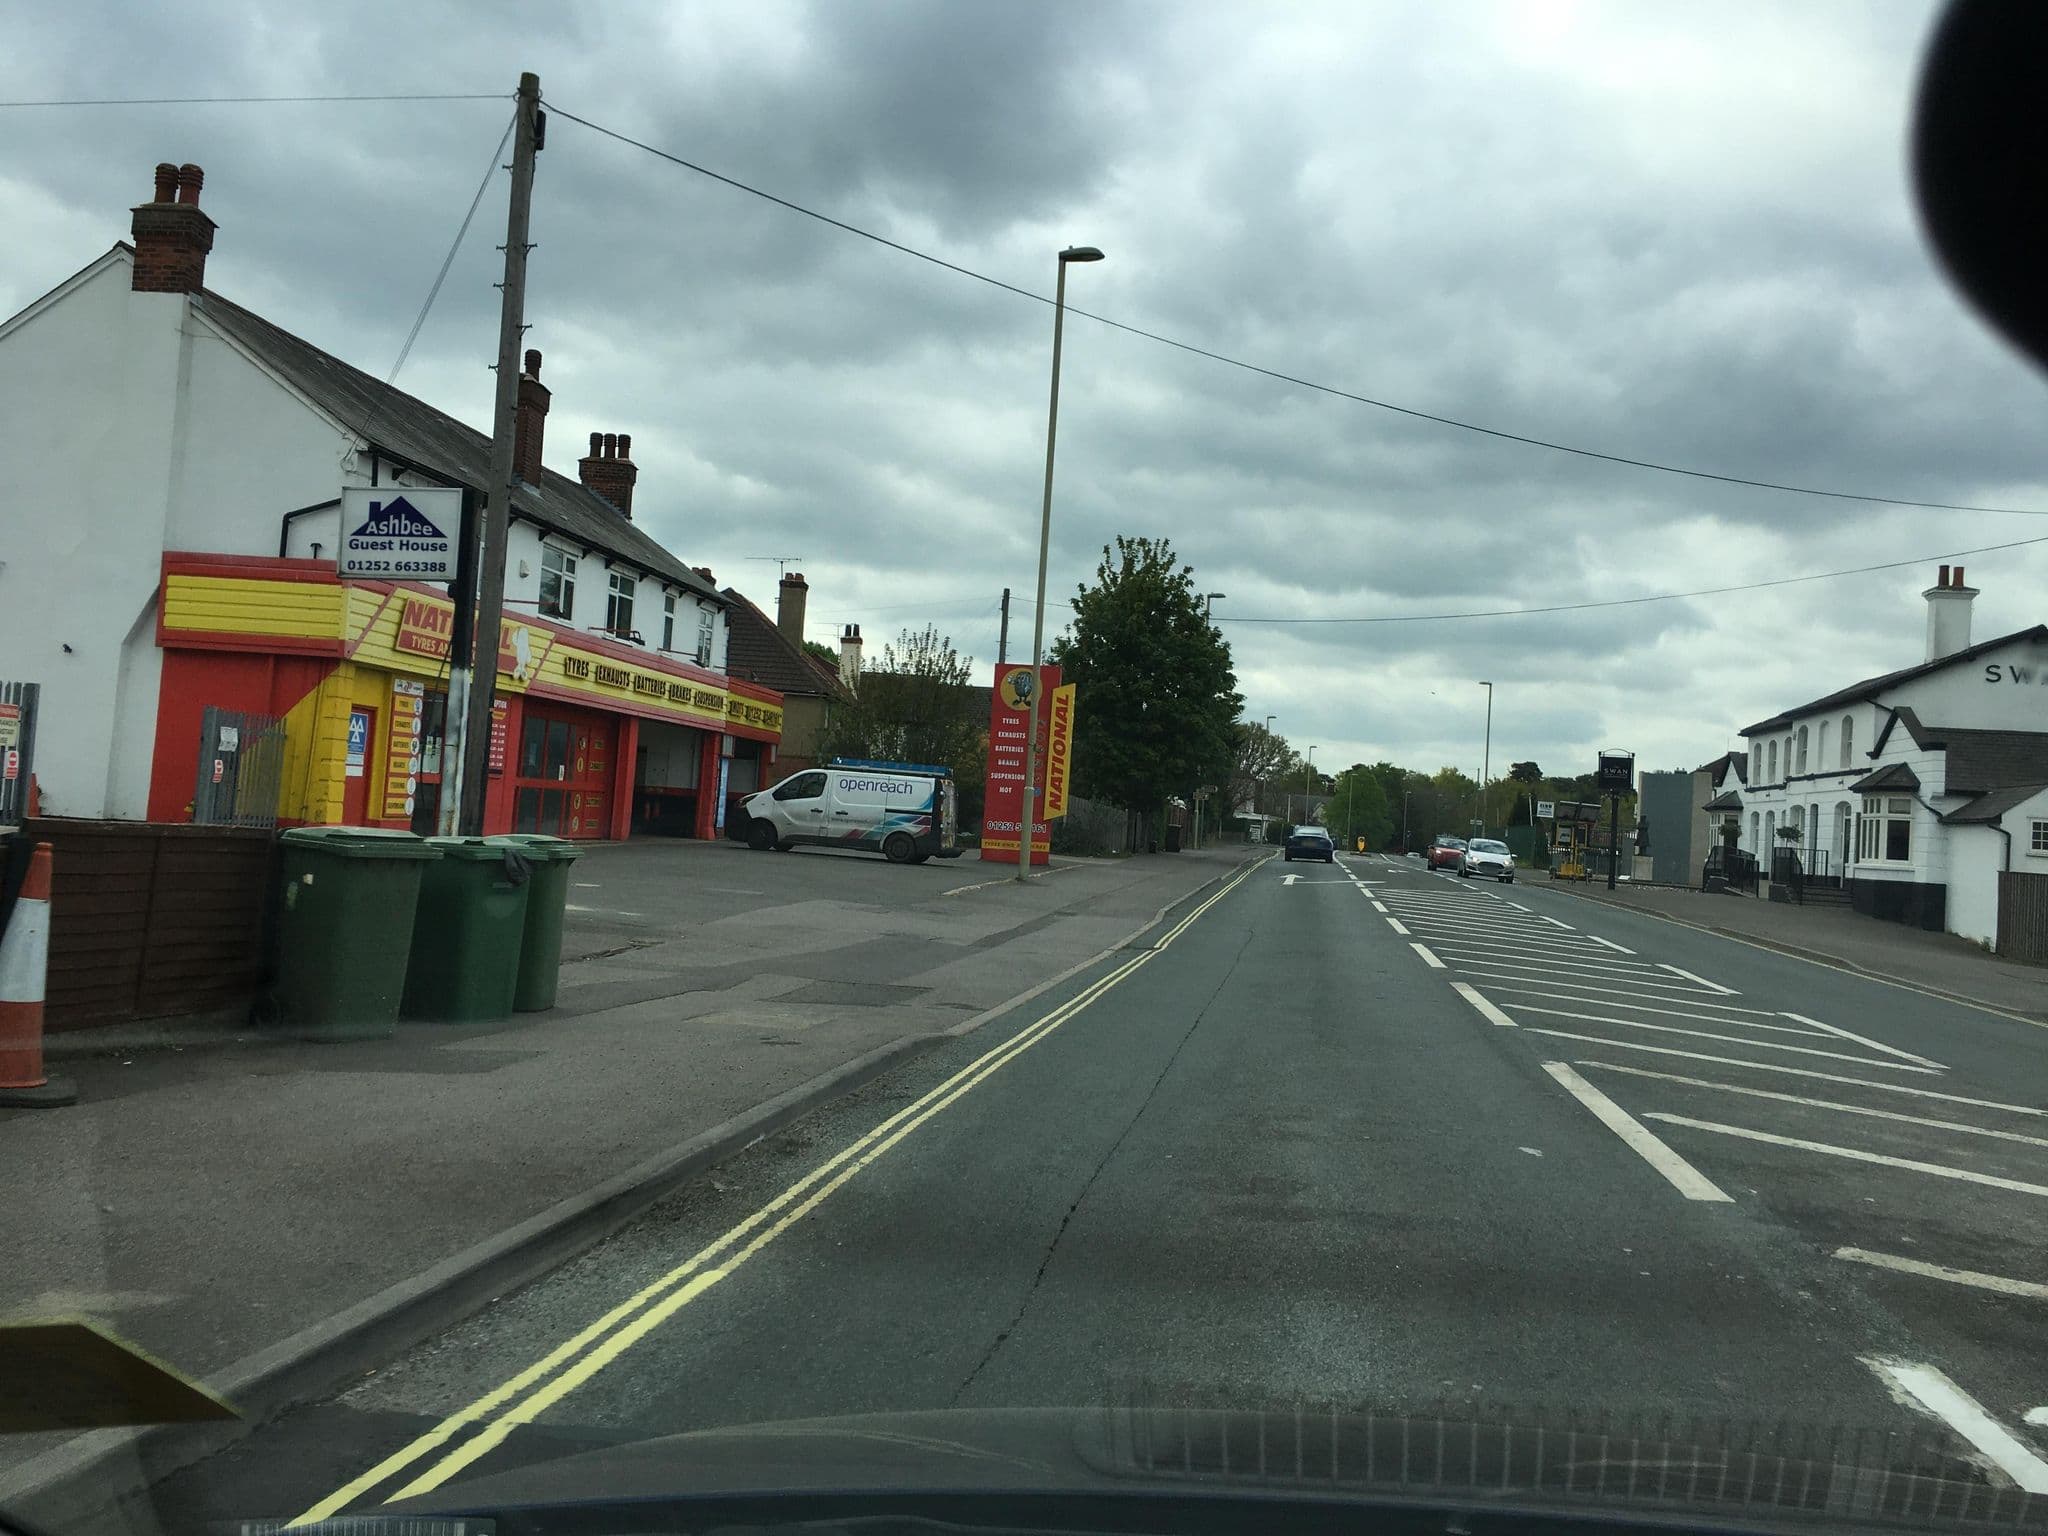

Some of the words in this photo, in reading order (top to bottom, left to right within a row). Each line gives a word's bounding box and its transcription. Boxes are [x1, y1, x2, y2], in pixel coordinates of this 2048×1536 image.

[365, 513, 433, 536] Ashbee
[349, 539, 394, 551] Guest
[399, 541, 448, 552] House
[347, 560, 390, 571] 01252
[394, 562, 447, 572] 663388
[411, 635, 436, 652] TYRES
[566, 657, 590, 678] TYRES
[597, 665, 631, 688] EXHAUSTS
[635, 674, 667, 697] BATTERIES
[671, 685, 692, 701] BRAKES
[695, 691, 724, 710] SUSPENSION
[1002, 717, 1020, 725] TYRES
[998, 731, 1026, 739] EXHAUSTS
[995, 745, 1024, 753] BATTERIES
[1049, 694, 1069, 811] NATIONAL
[998, 759, 1020, 767] BRAKES
[990, 772, 1025, 781] SUSPENSION
[1603, 767, 1629, 775] SWAN
[840, 778, 913, 795] openreach
[986, 820, 1014, 832] 01252
